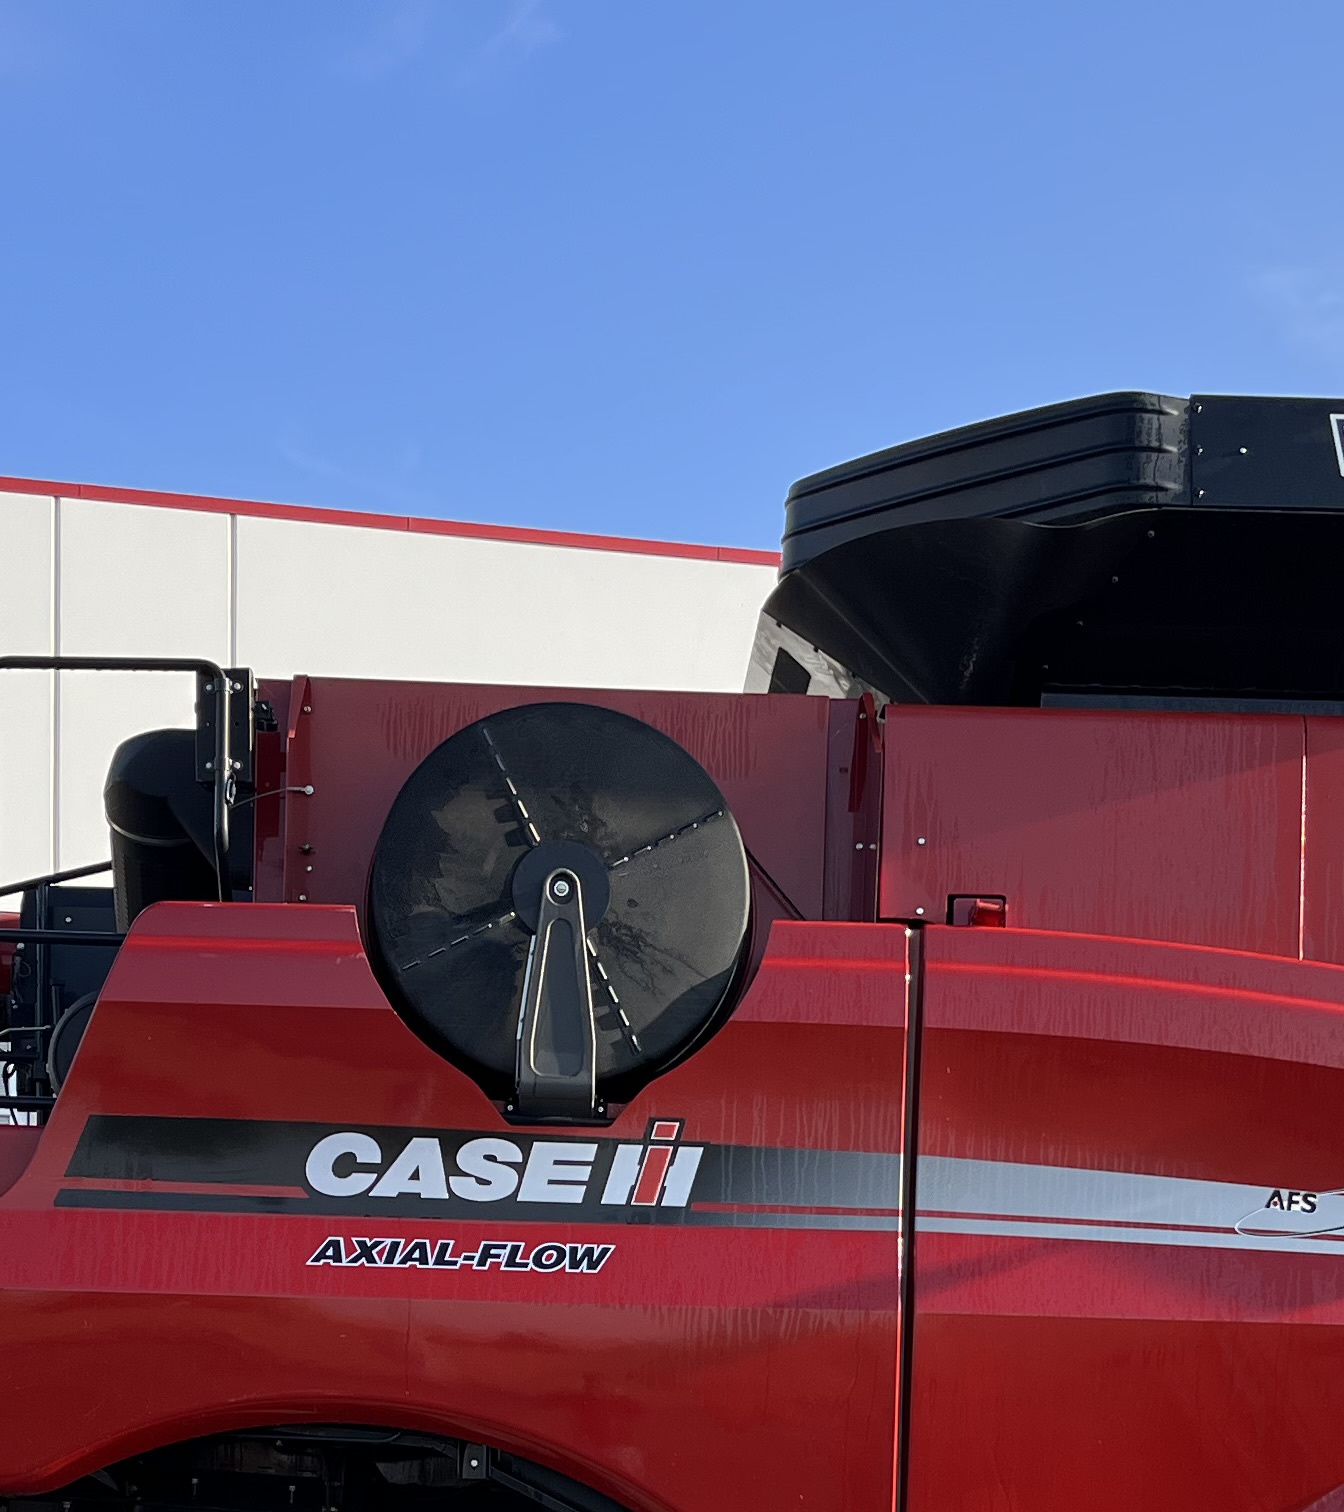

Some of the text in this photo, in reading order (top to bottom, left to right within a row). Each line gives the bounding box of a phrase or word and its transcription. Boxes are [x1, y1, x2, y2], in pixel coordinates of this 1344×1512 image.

[305, 1132, 598, 1203] CASE
[1265, 1190, 1317, 1214] AFS
[306, 1237, 616, 1273] AXIAL-FLOW
